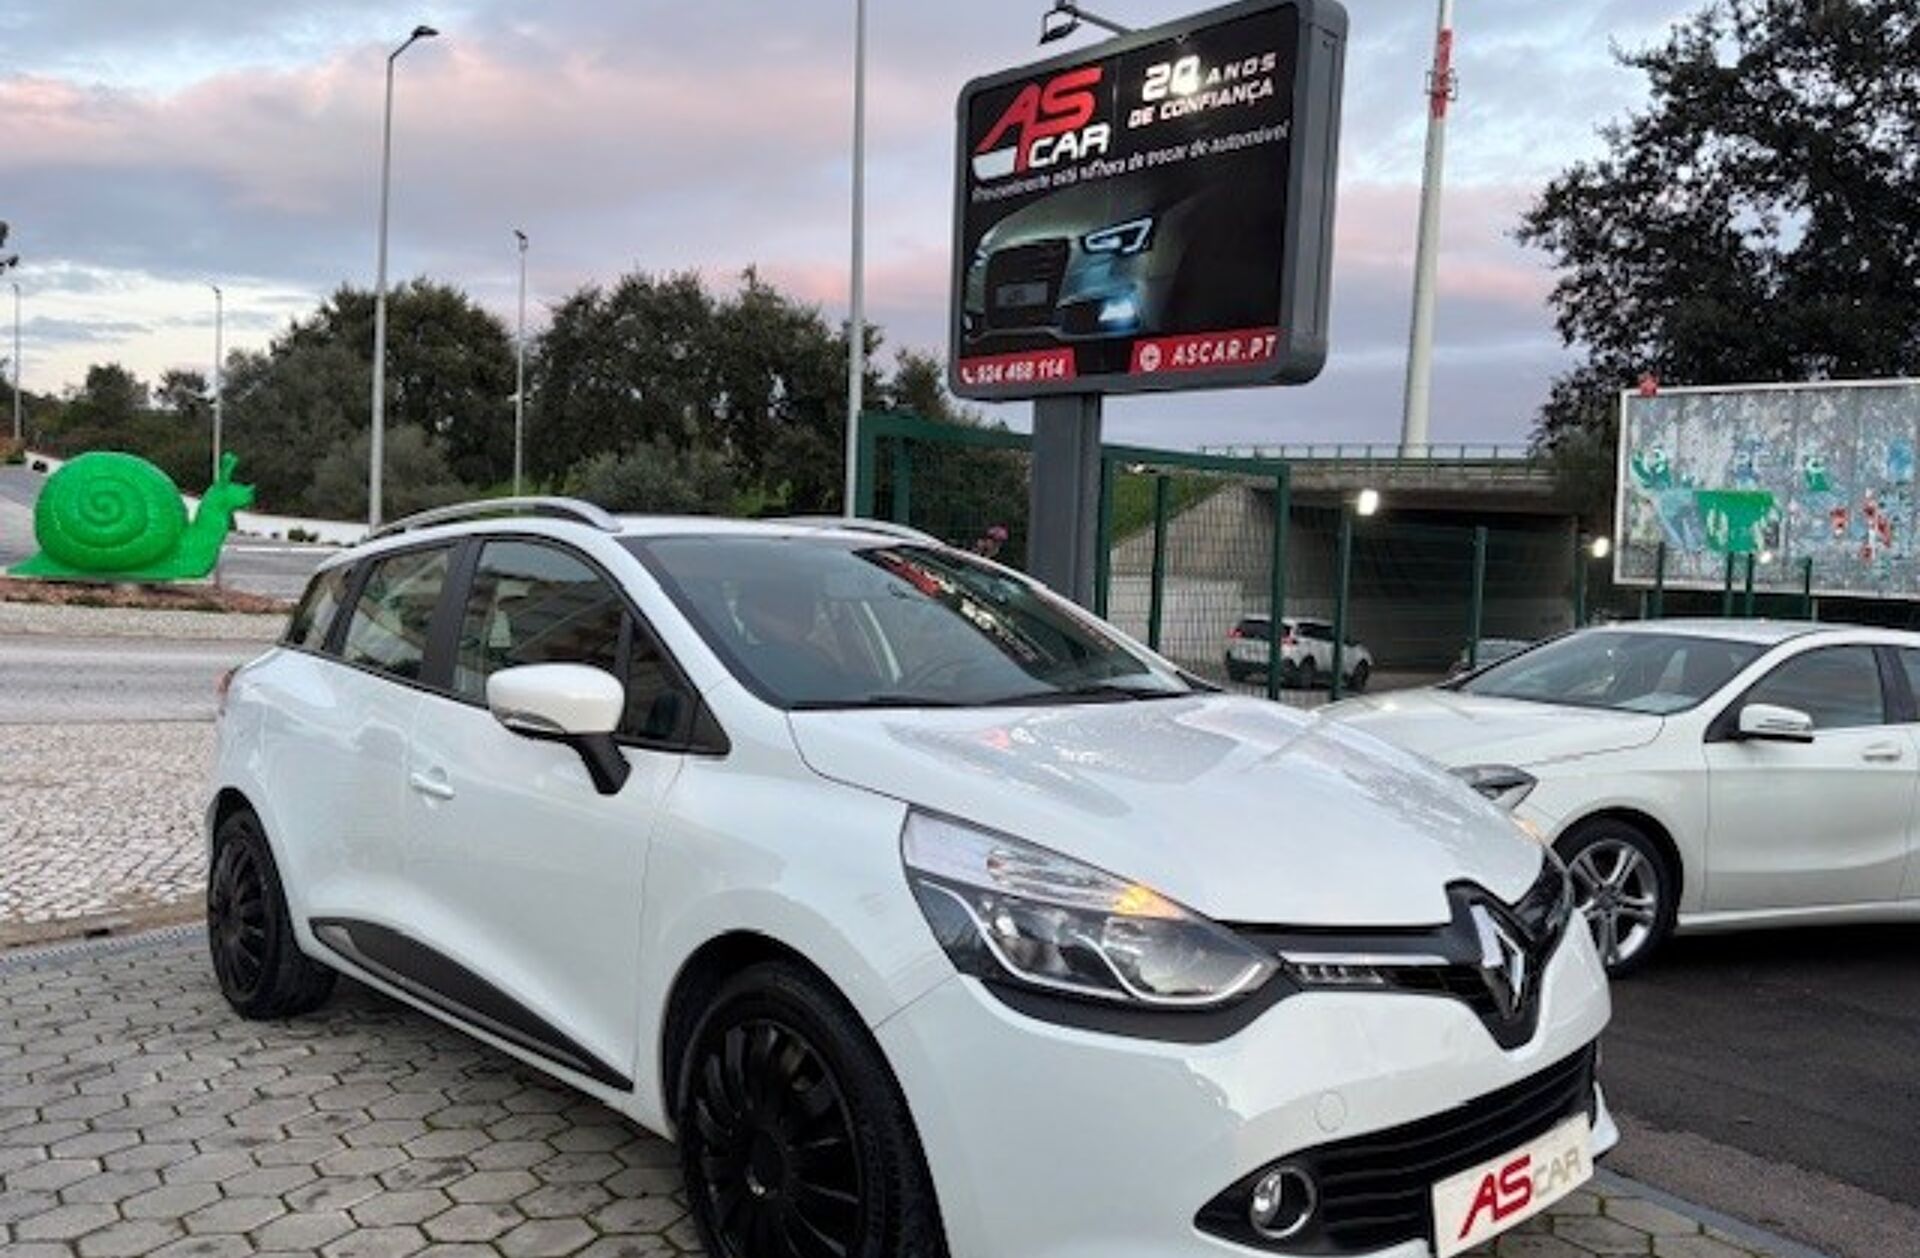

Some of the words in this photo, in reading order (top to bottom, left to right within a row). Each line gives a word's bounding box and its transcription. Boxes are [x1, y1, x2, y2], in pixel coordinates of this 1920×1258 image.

[1142, 54, 1200, 101] 20
[1206, 52, 1277, 84] ANOS
[974, 66, 1104, 172] AS
[1128, 106, 1155, 128] DE
[1160, 77, 1273, 120] CONFIANÇA
[1028, 122, 1110, 168] CAR
[1172, 335, 1276, 366] ASCAR.PT
[1457, 1154, 1531, 1241] AS
[1532, 1149, 1582, 1201] CAR
